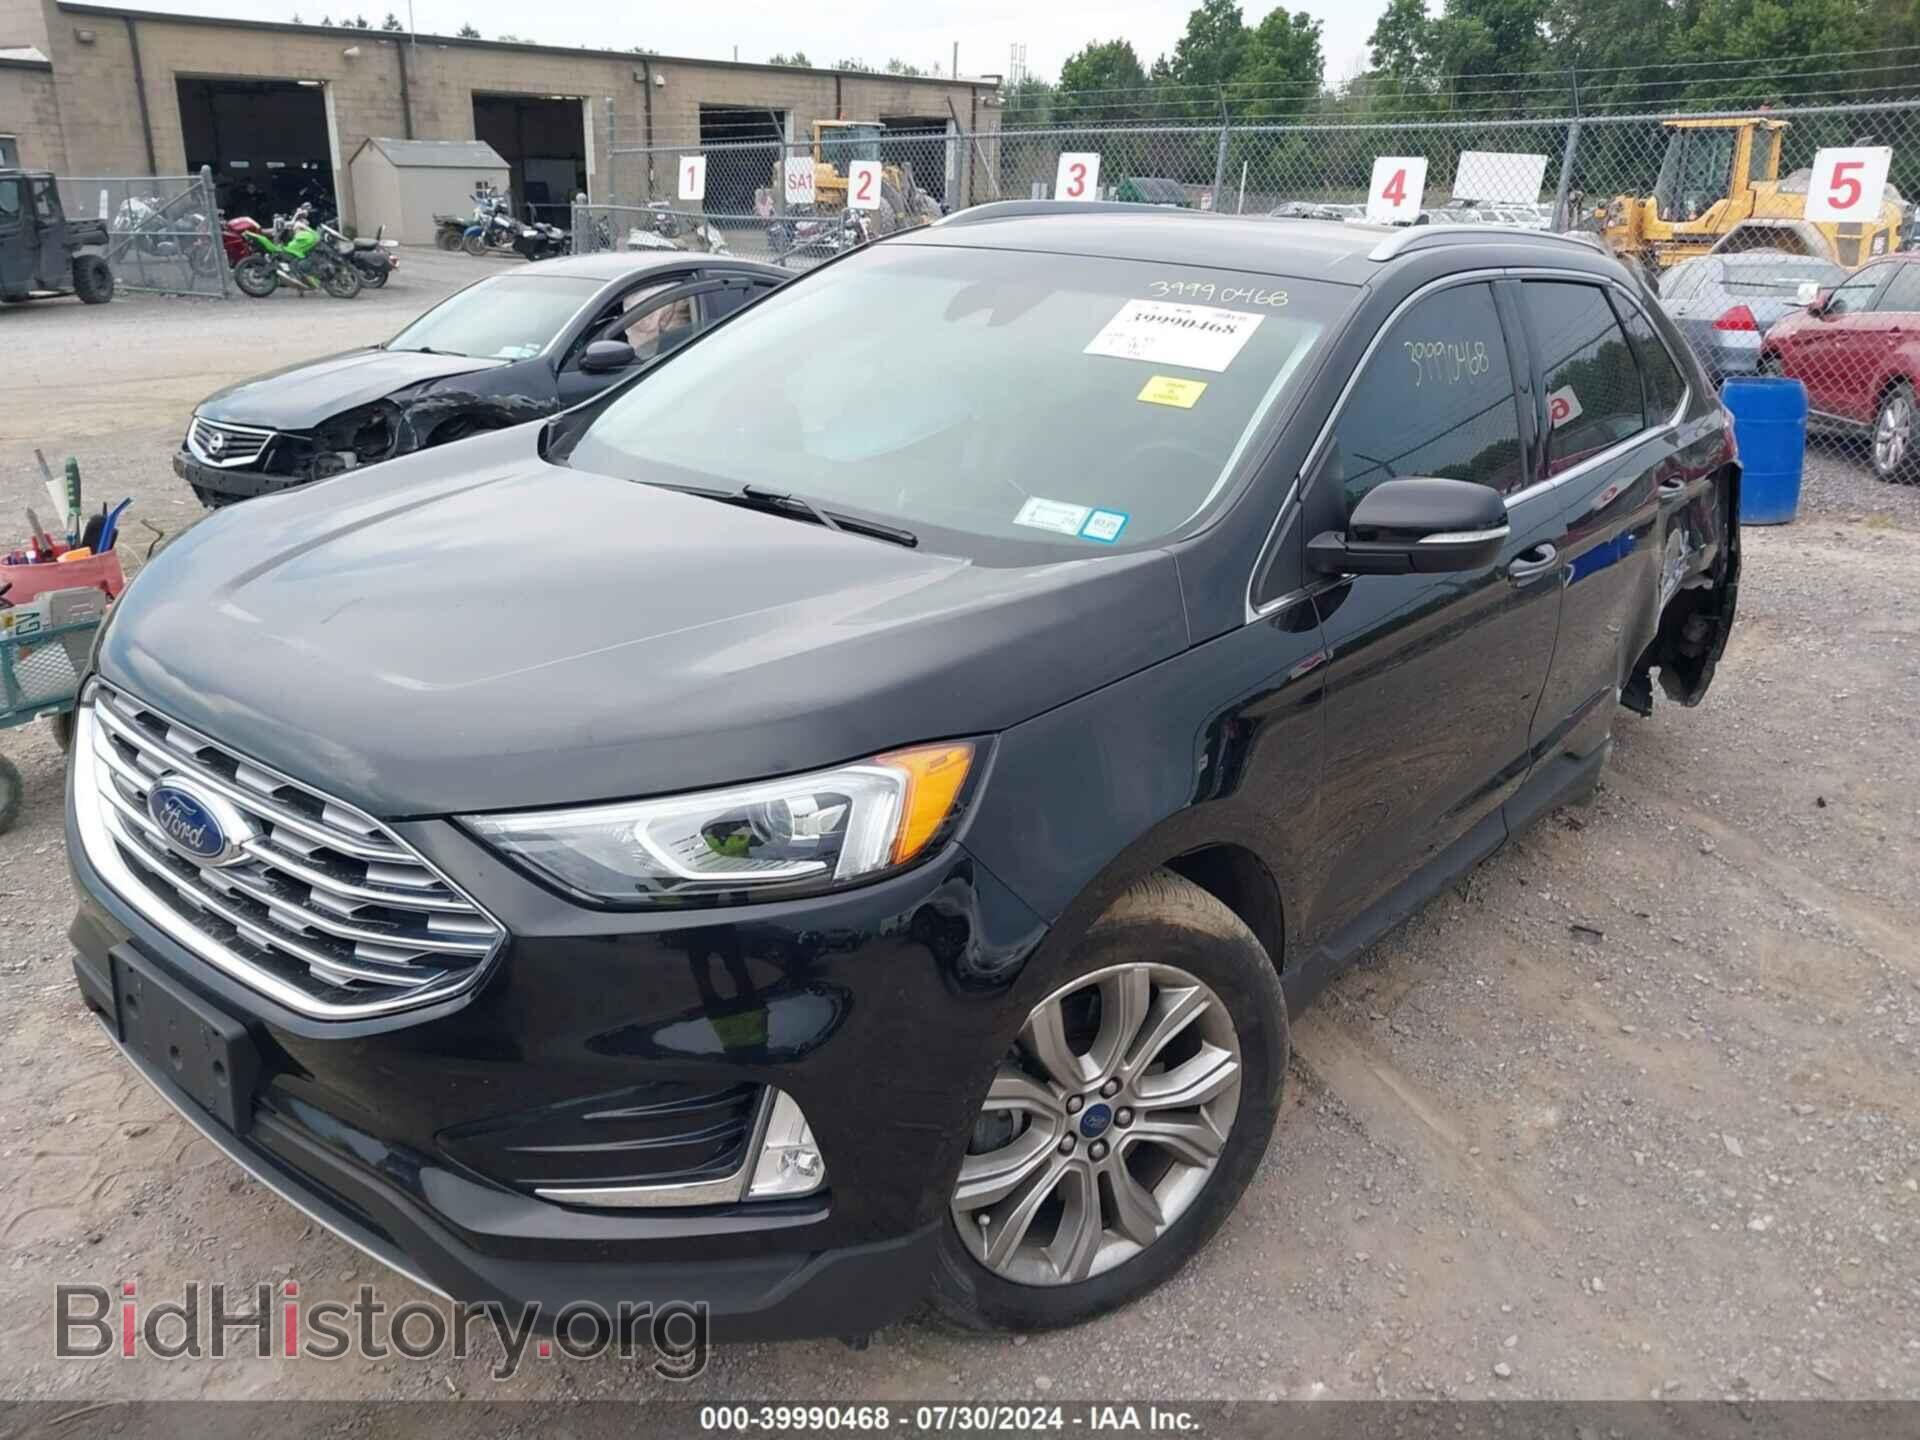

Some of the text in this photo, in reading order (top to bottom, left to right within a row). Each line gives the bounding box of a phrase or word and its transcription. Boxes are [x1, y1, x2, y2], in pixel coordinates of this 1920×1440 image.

[687, 165, 696, 193] 1
[788, 174, 813, 191] SA1
[856, 170, 873, 201] 2
[1067, 162, 1087, 198] 3
[1381, 168, 1407, 208] 4
[1827, 161, 1865, 209] 5
[160, 795, 208, 849] Ford
